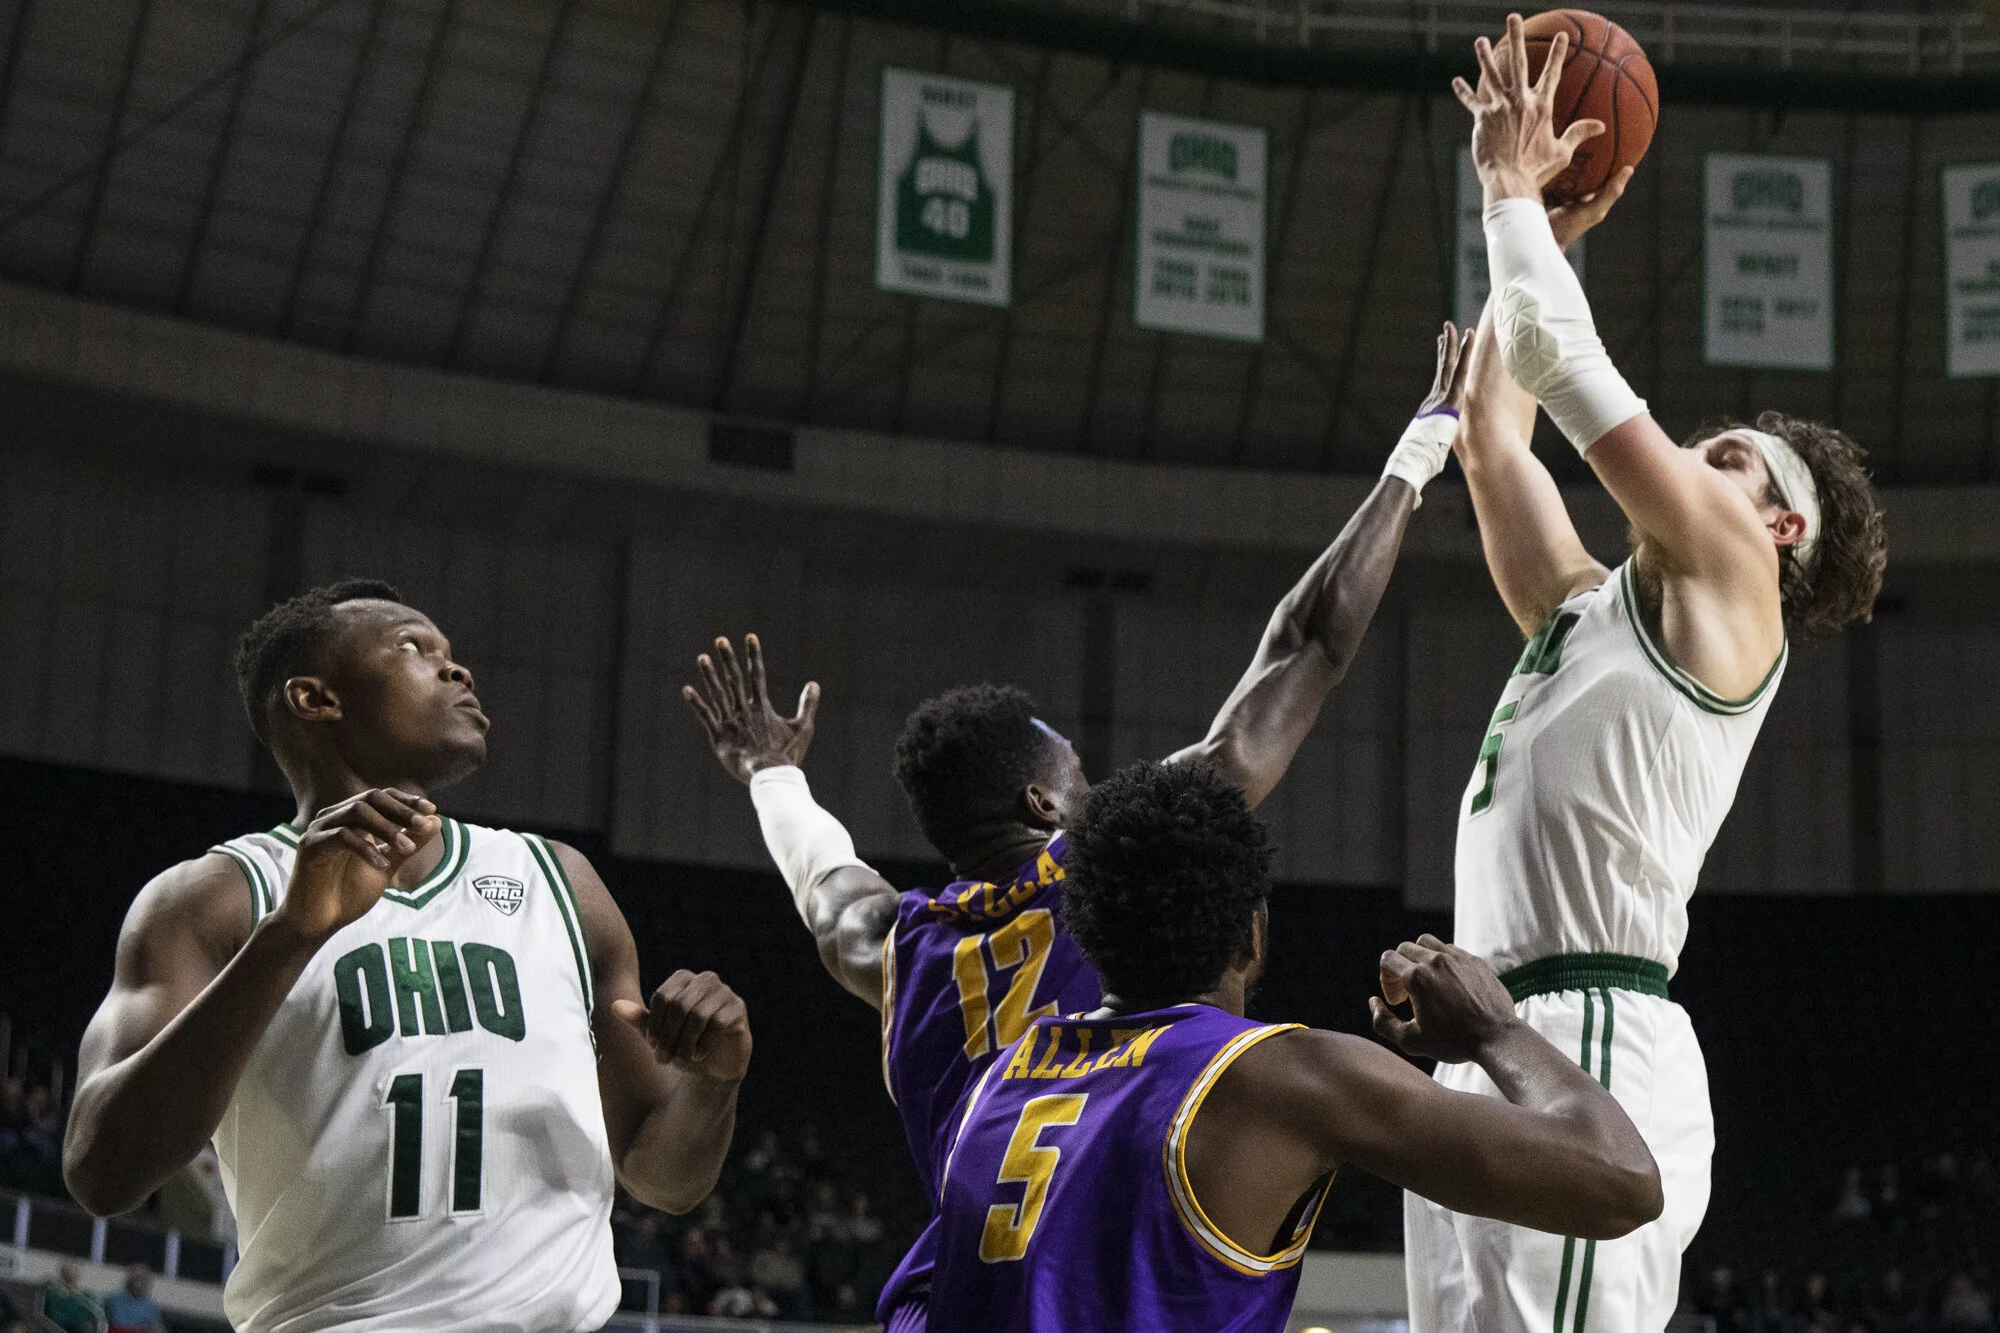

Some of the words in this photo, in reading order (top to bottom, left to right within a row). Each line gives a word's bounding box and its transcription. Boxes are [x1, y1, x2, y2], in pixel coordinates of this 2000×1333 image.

[922, 196, 970, 240] 40
[480, 887, 523, 900] MAC
[334, 936, 526, 1056] OHIO
[953, 908, 1059, 1062] 12
[1002, 1024, 1175, 1081] ALLEN
[380, 1066, 484, 1222] 11
[979, 1093, 1089, 1264] 5
